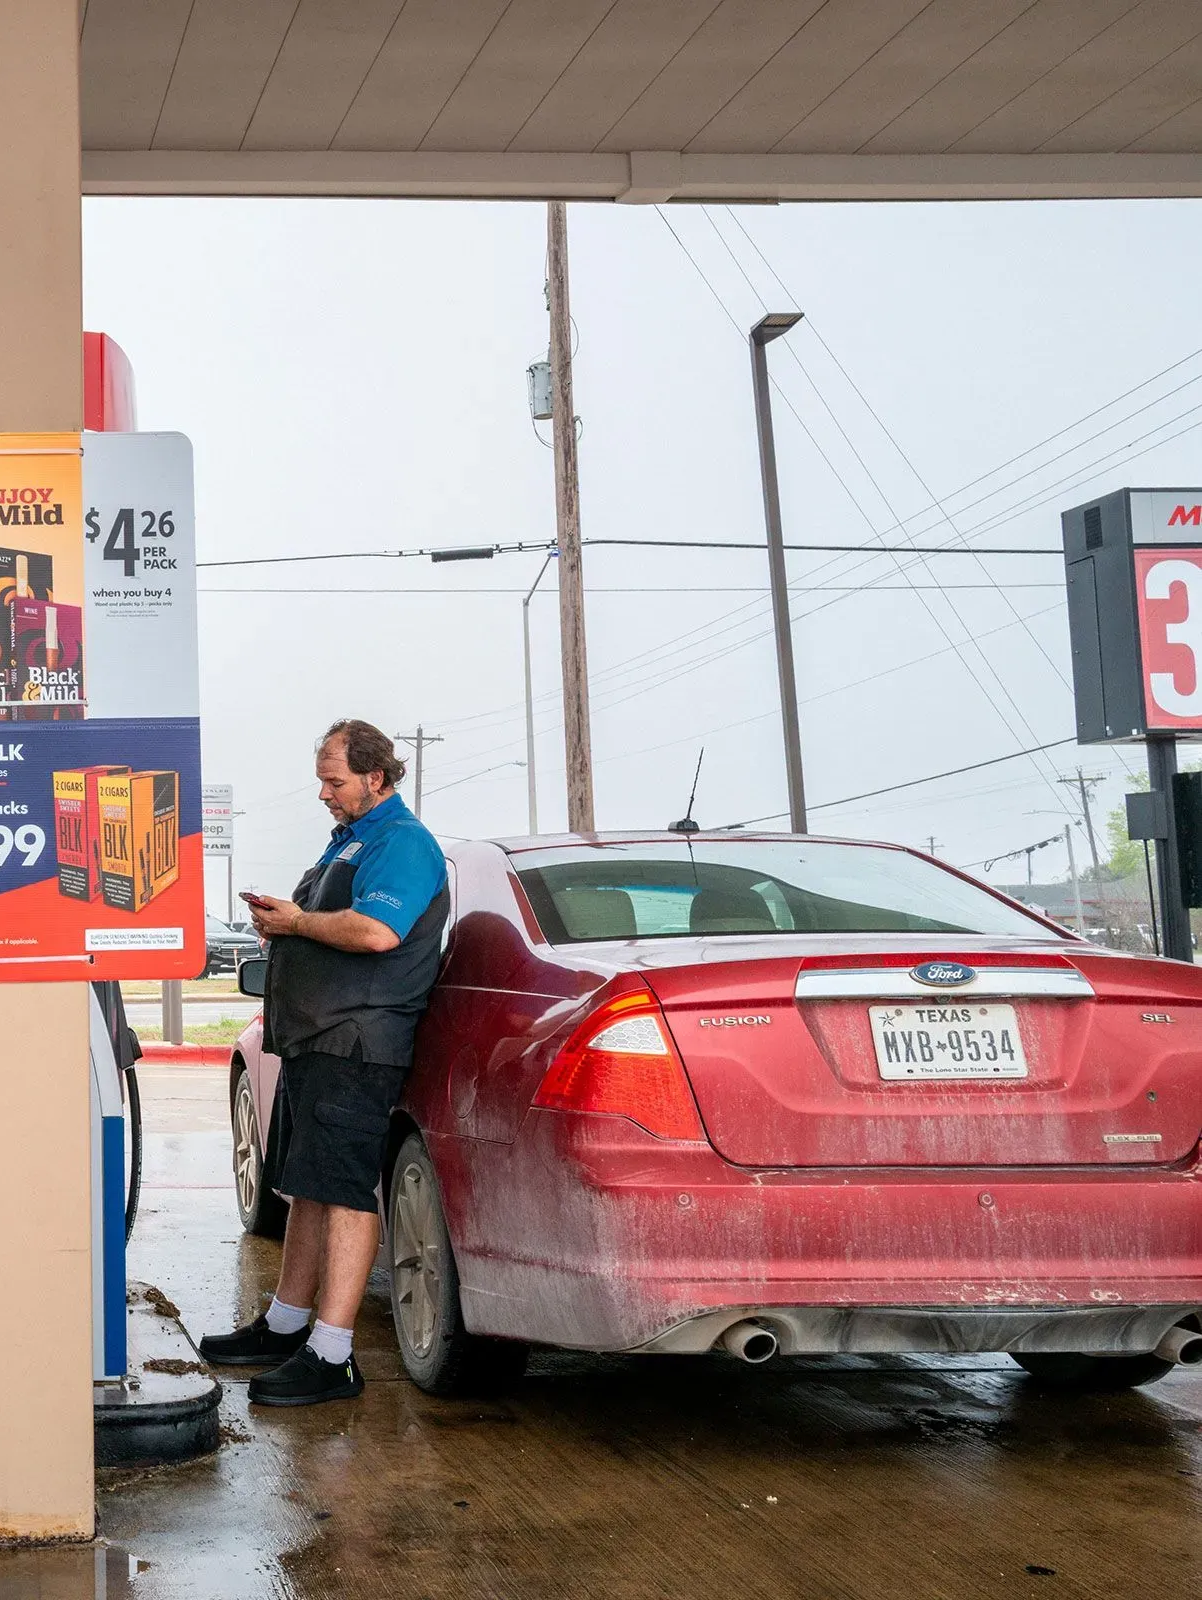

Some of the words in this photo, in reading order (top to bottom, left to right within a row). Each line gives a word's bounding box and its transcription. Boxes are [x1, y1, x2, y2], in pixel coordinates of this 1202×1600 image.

[143, 547, 167, 557] PER
[143, 558, 177, 569] PACK
[93, 588, 121, 597] when
[123, 590, 142, 599] you
[144, 588, 163, 599] buy
[165, 588, 172, 597] 4
[24, 607, 38, 615] WINE
[1145, 559, 1202, 717] 3
[28, 666, 79, 686] Black
[40, 685, 79, 701] Mild
[56, 782, 60, 791] 2
[61, 782, 84, 792] CIGARS
[100, 787, 104, 796] 2
[105, 787, 129, 798] CIGARS
[59, 816, 83, 853] BLK
[202, 825, 224, 835] eep
[103, 823, 128, 861] BLK
[927, 964, 964, 980] Ford
[700, 1015, 771, 1027] FUSION
[916, 1009, 972, 1023] TEXAS
[1141, 1013, 1176, 1023] SEL
